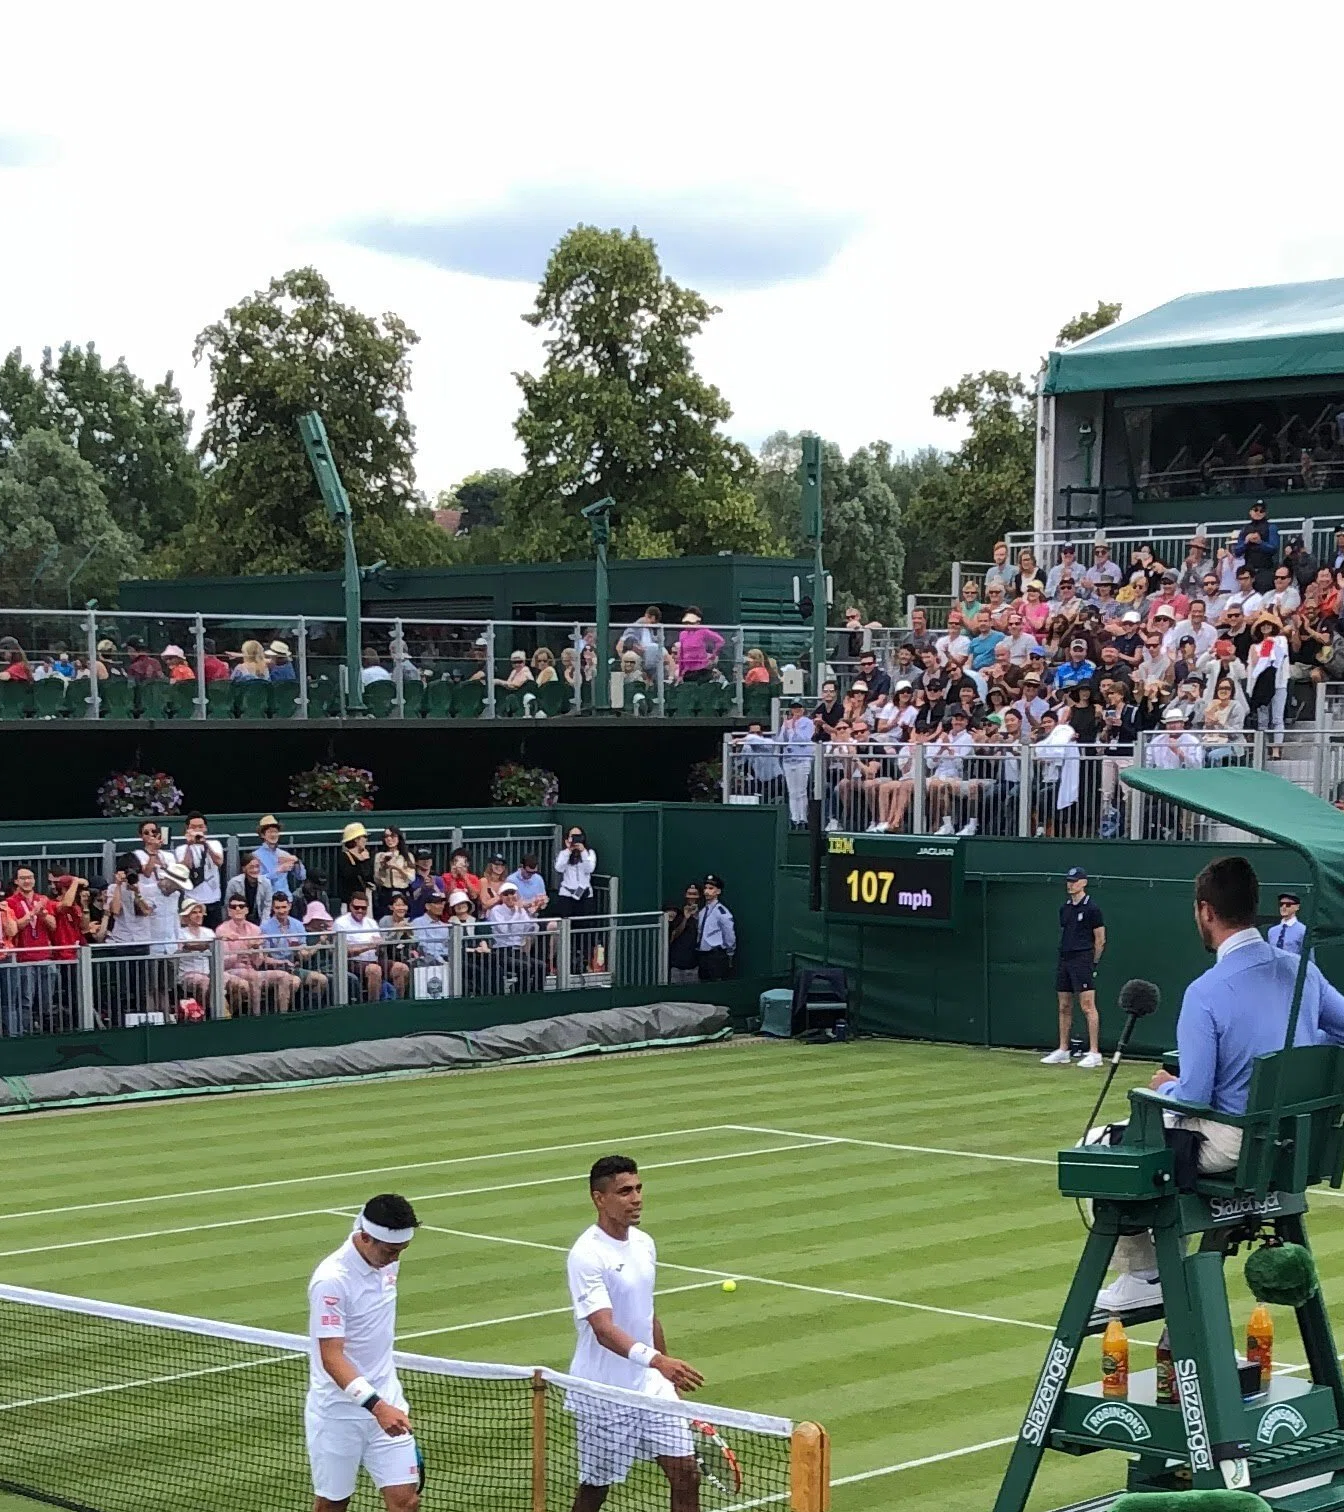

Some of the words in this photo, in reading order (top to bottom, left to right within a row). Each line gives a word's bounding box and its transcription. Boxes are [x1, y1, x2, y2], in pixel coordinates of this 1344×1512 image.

[828, 837, 855, 855] IBM
[916, 847, 955, 857] JAGUAR
[846, 869, 895, 904] 107
[898, 888, 932, 911] mph
[1022, 1339, 1072, 1445] Slazenger
[1089, 1404, 1146, 1438] ROBINSONS
[1178, 1358, 1212, 1472] Slazenger
[1261, 1407, 1302, 1439] ROBINSONS
